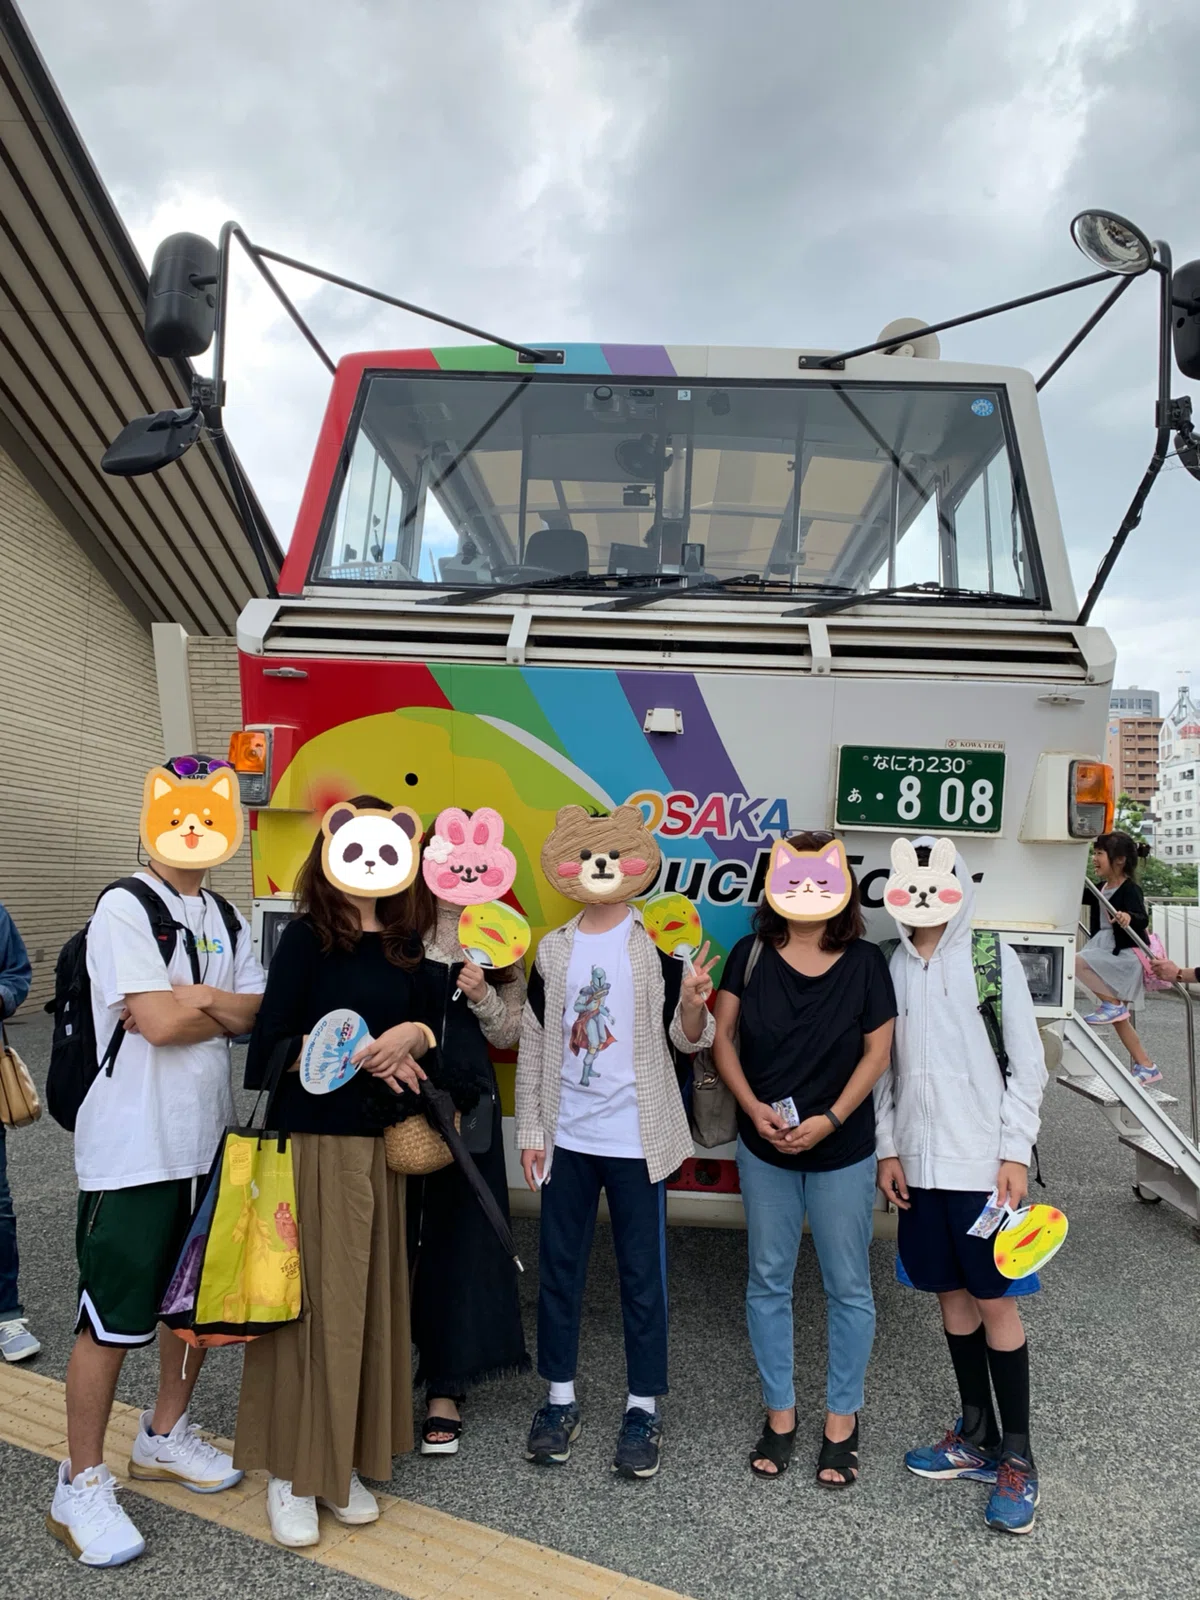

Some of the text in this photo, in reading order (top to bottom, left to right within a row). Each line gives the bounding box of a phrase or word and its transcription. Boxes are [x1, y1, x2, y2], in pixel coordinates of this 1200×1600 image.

[960, 741, 982, 749] KOWA
[872, 754, 966, 774] なにわ230
[847, 787, 862, 804] あ
[629, 793, 790, 837] OSAKA
[640, 851, 771, 904] uc
